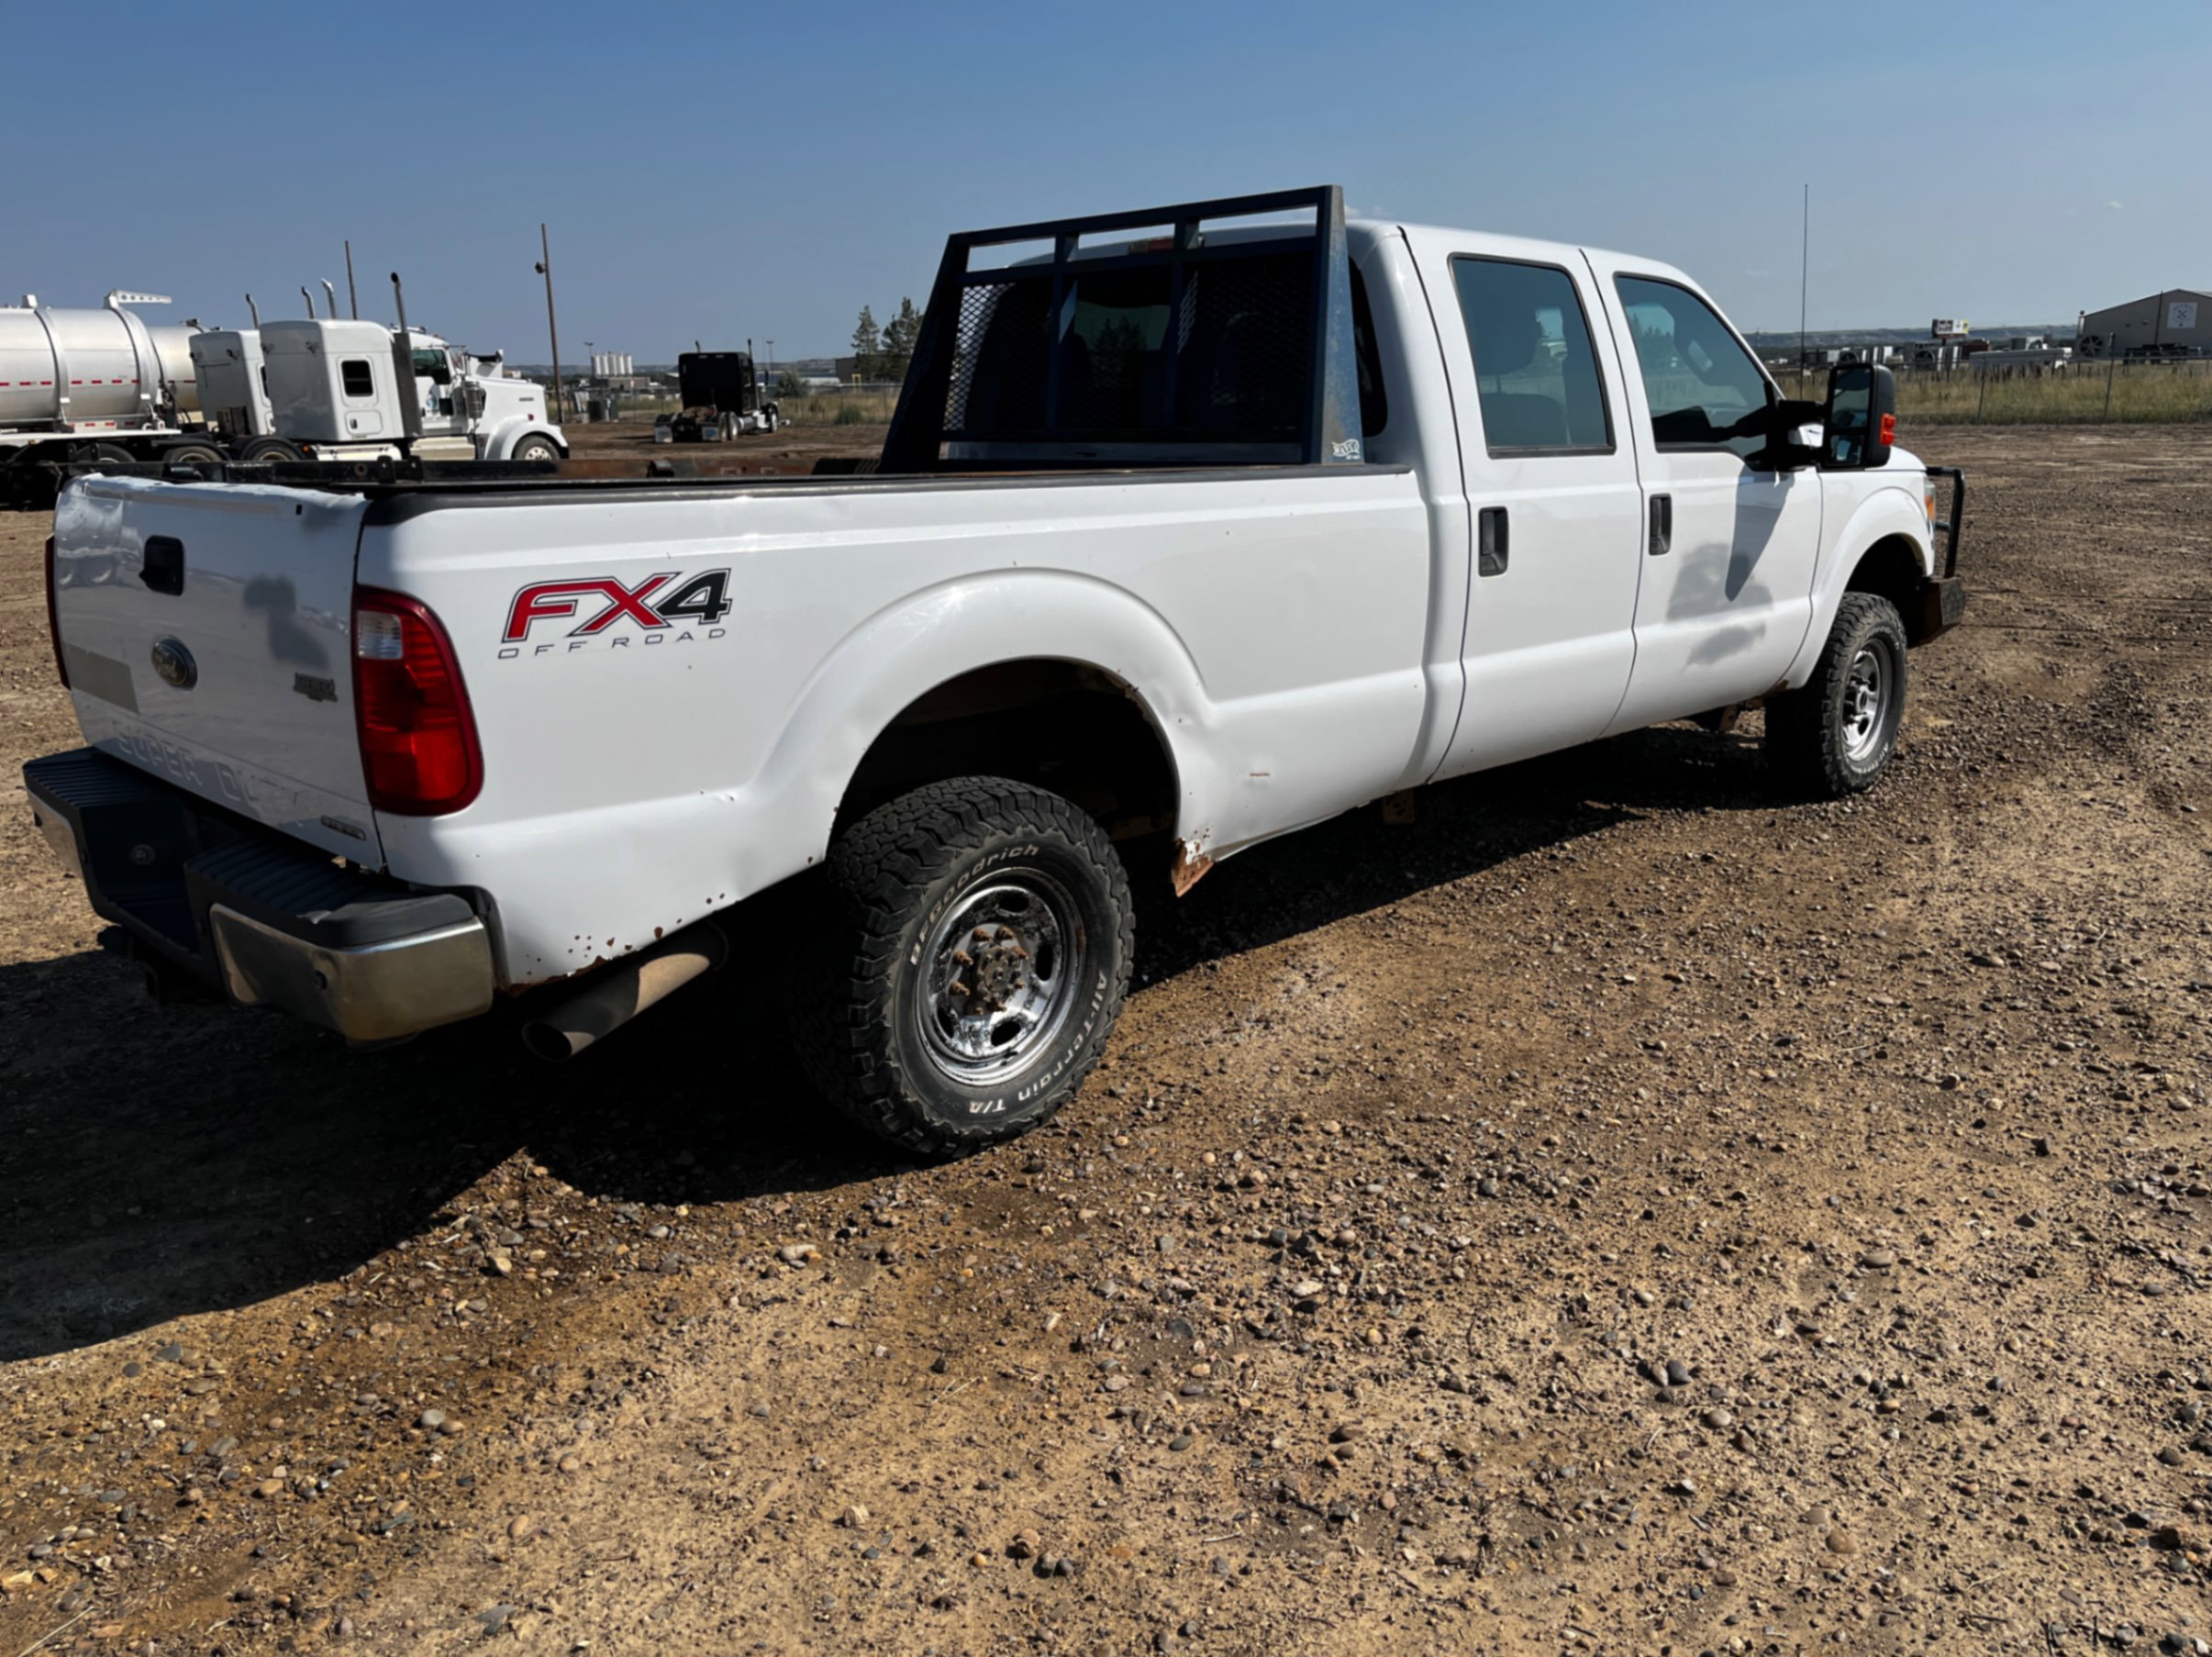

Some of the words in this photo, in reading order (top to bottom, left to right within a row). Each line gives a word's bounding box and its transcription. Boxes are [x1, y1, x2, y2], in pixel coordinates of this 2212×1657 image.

[502, 568, 732, 643] FX4
[498, 640, 588, 660] OFF
[611, 628, 726, 649] ROAD
[910, 844, 1039, 966] BFGoodrich
[1017, 970, 1107, 1102] All-Terrain
[969, 1098, 1006, 1114] T/A
